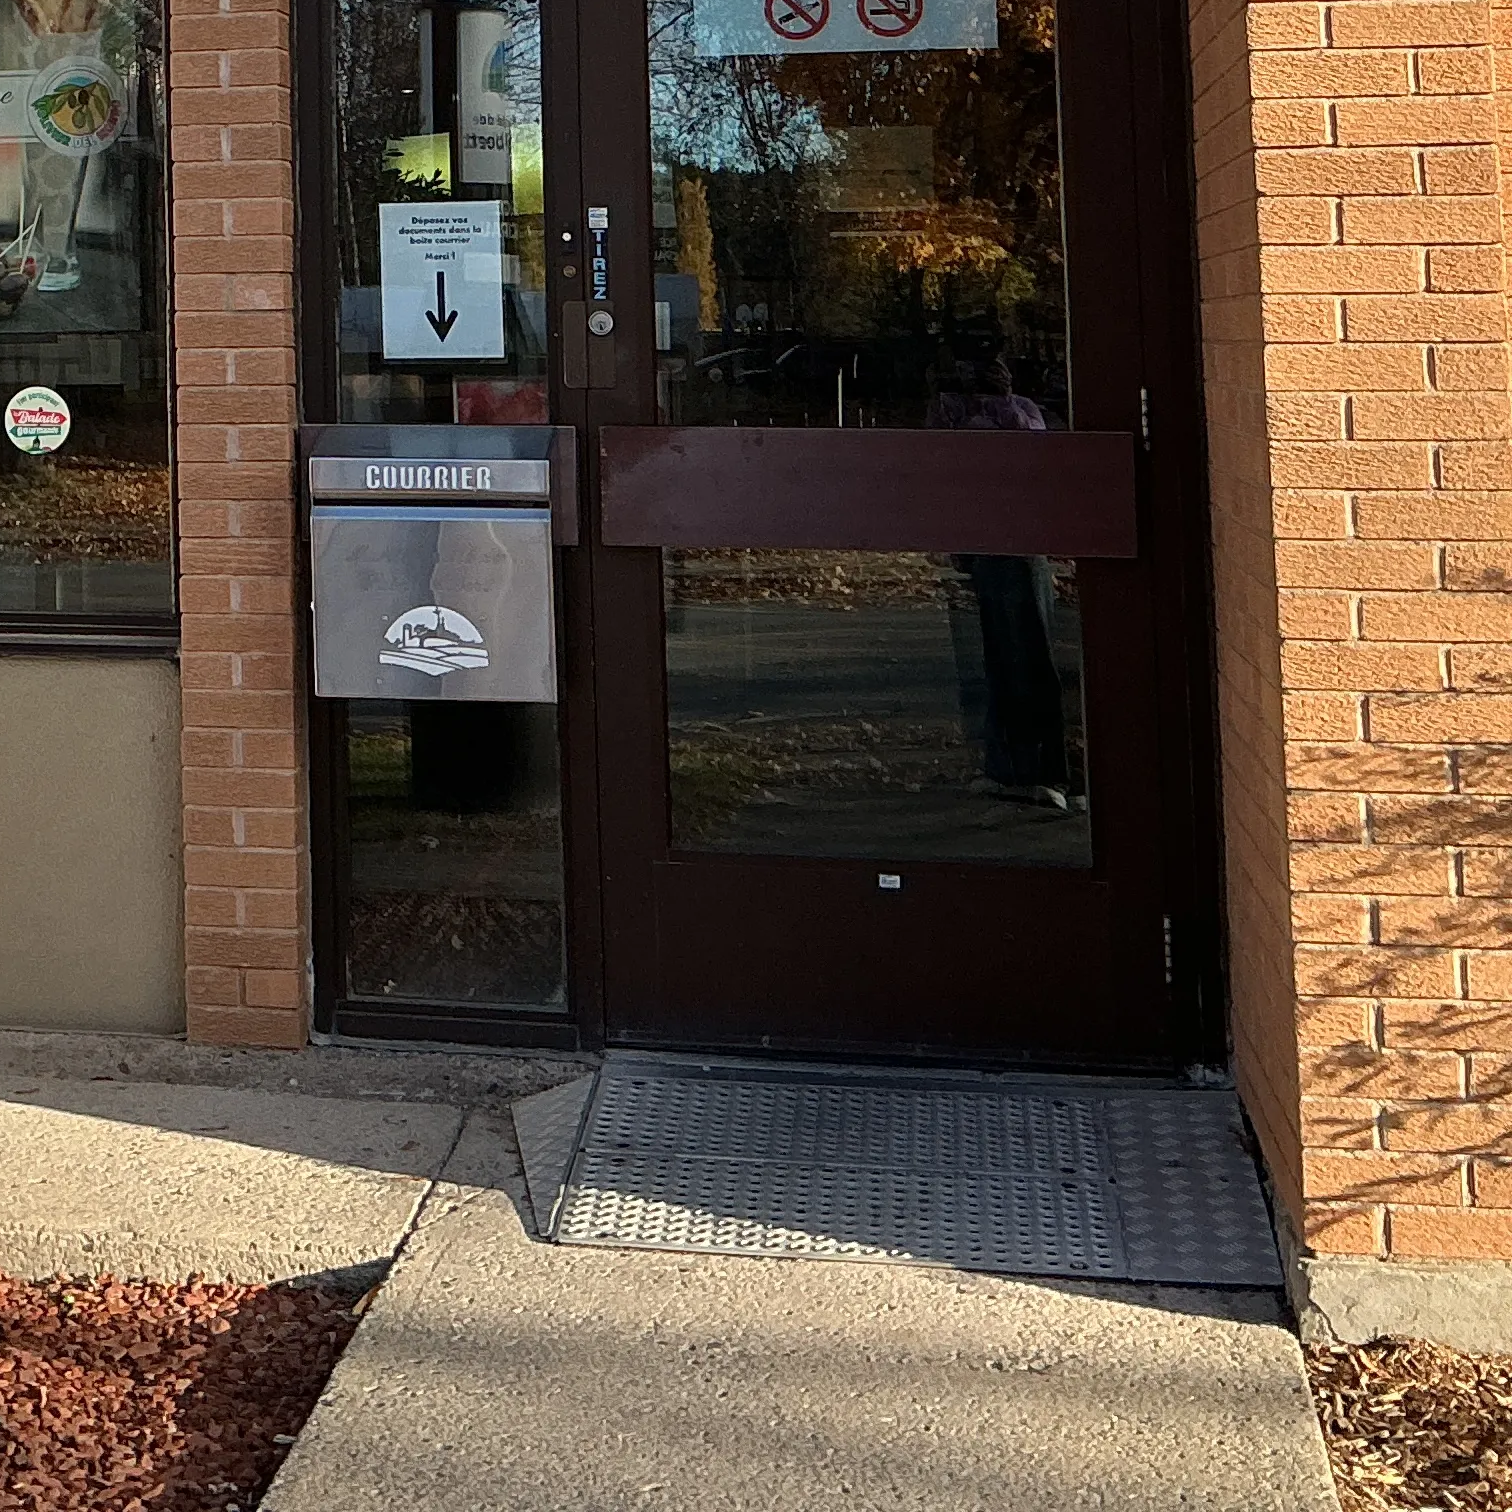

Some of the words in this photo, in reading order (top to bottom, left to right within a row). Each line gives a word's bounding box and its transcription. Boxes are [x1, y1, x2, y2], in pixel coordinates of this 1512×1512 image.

[398, 226, 446, 235] documents
[449, 226, 470, 234] dans
[473, 225, 482, 233] la
[425, 251, 449, 261] Merci
[592, 229, 607, 300] TIREZ
[18, 410, 61, 423] Balade
[365, 465, 491, 490] COURRIER
